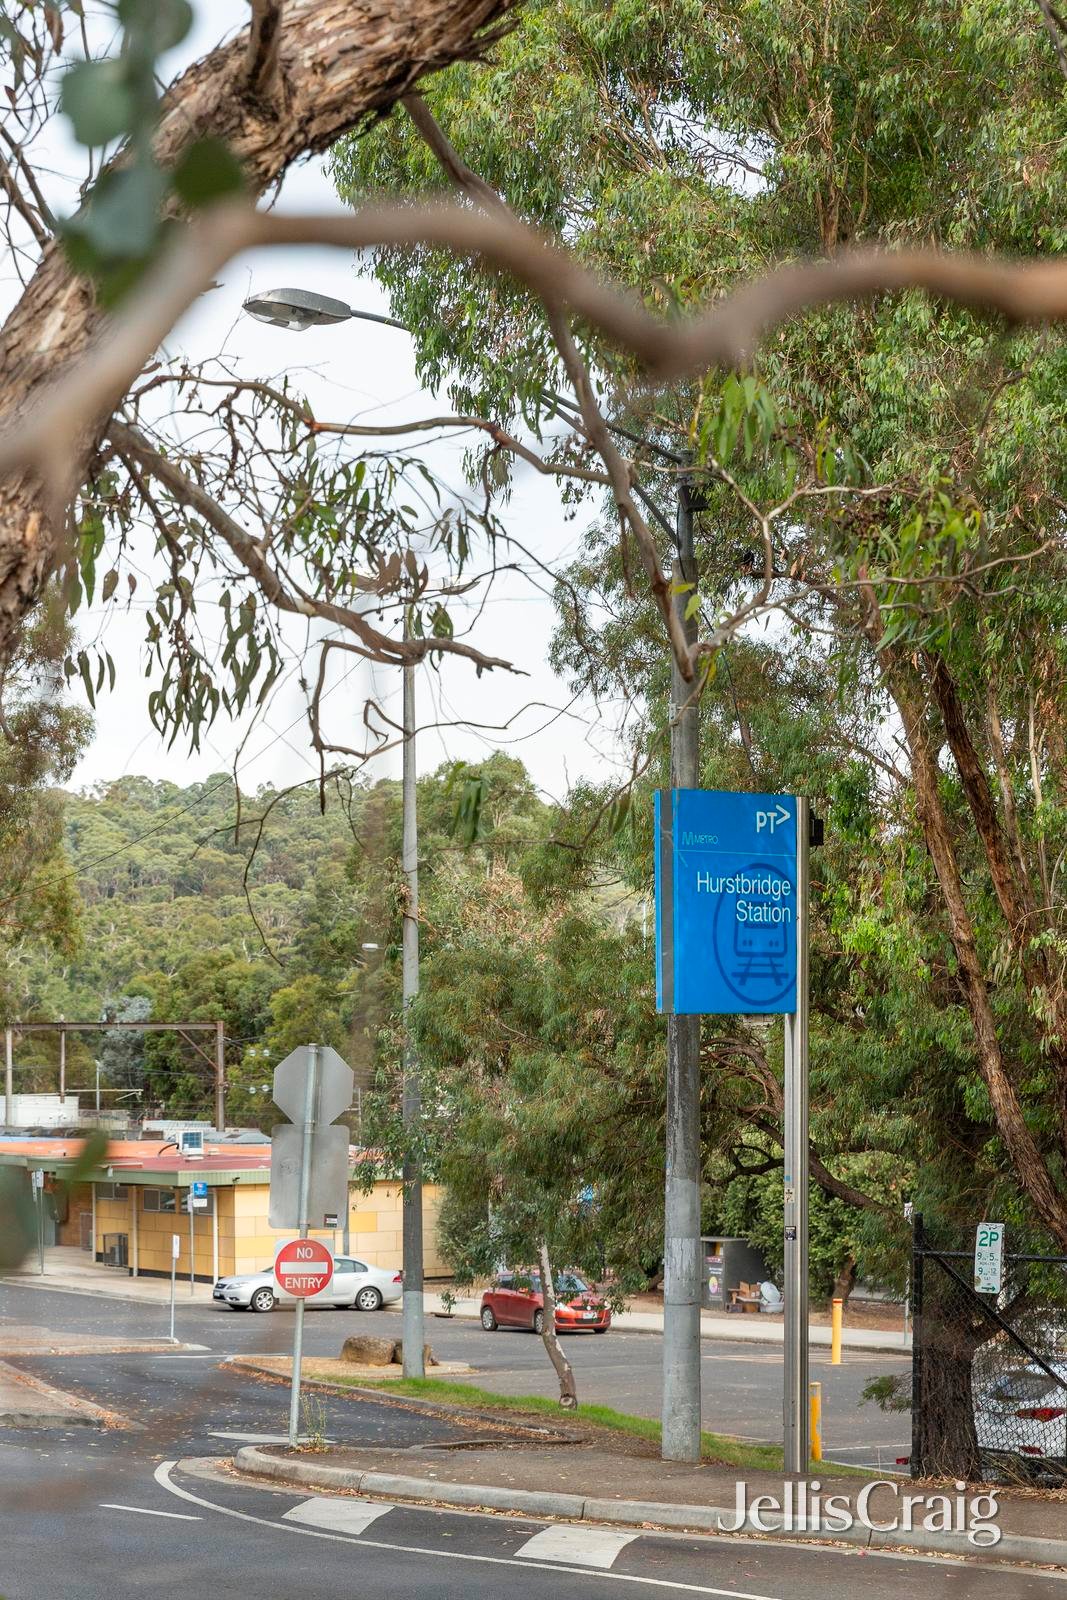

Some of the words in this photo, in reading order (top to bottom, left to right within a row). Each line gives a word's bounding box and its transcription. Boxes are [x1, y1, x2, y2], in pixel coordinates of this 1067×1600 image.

[697, 871, 791, 900] Hurstbridge
[736, 900, 791, 923] Station
[978, 1230, 999, 1247] 2P
[296, 1247, 313, 1259] NO
[285, 1277, 324, 1289] ENTRY
